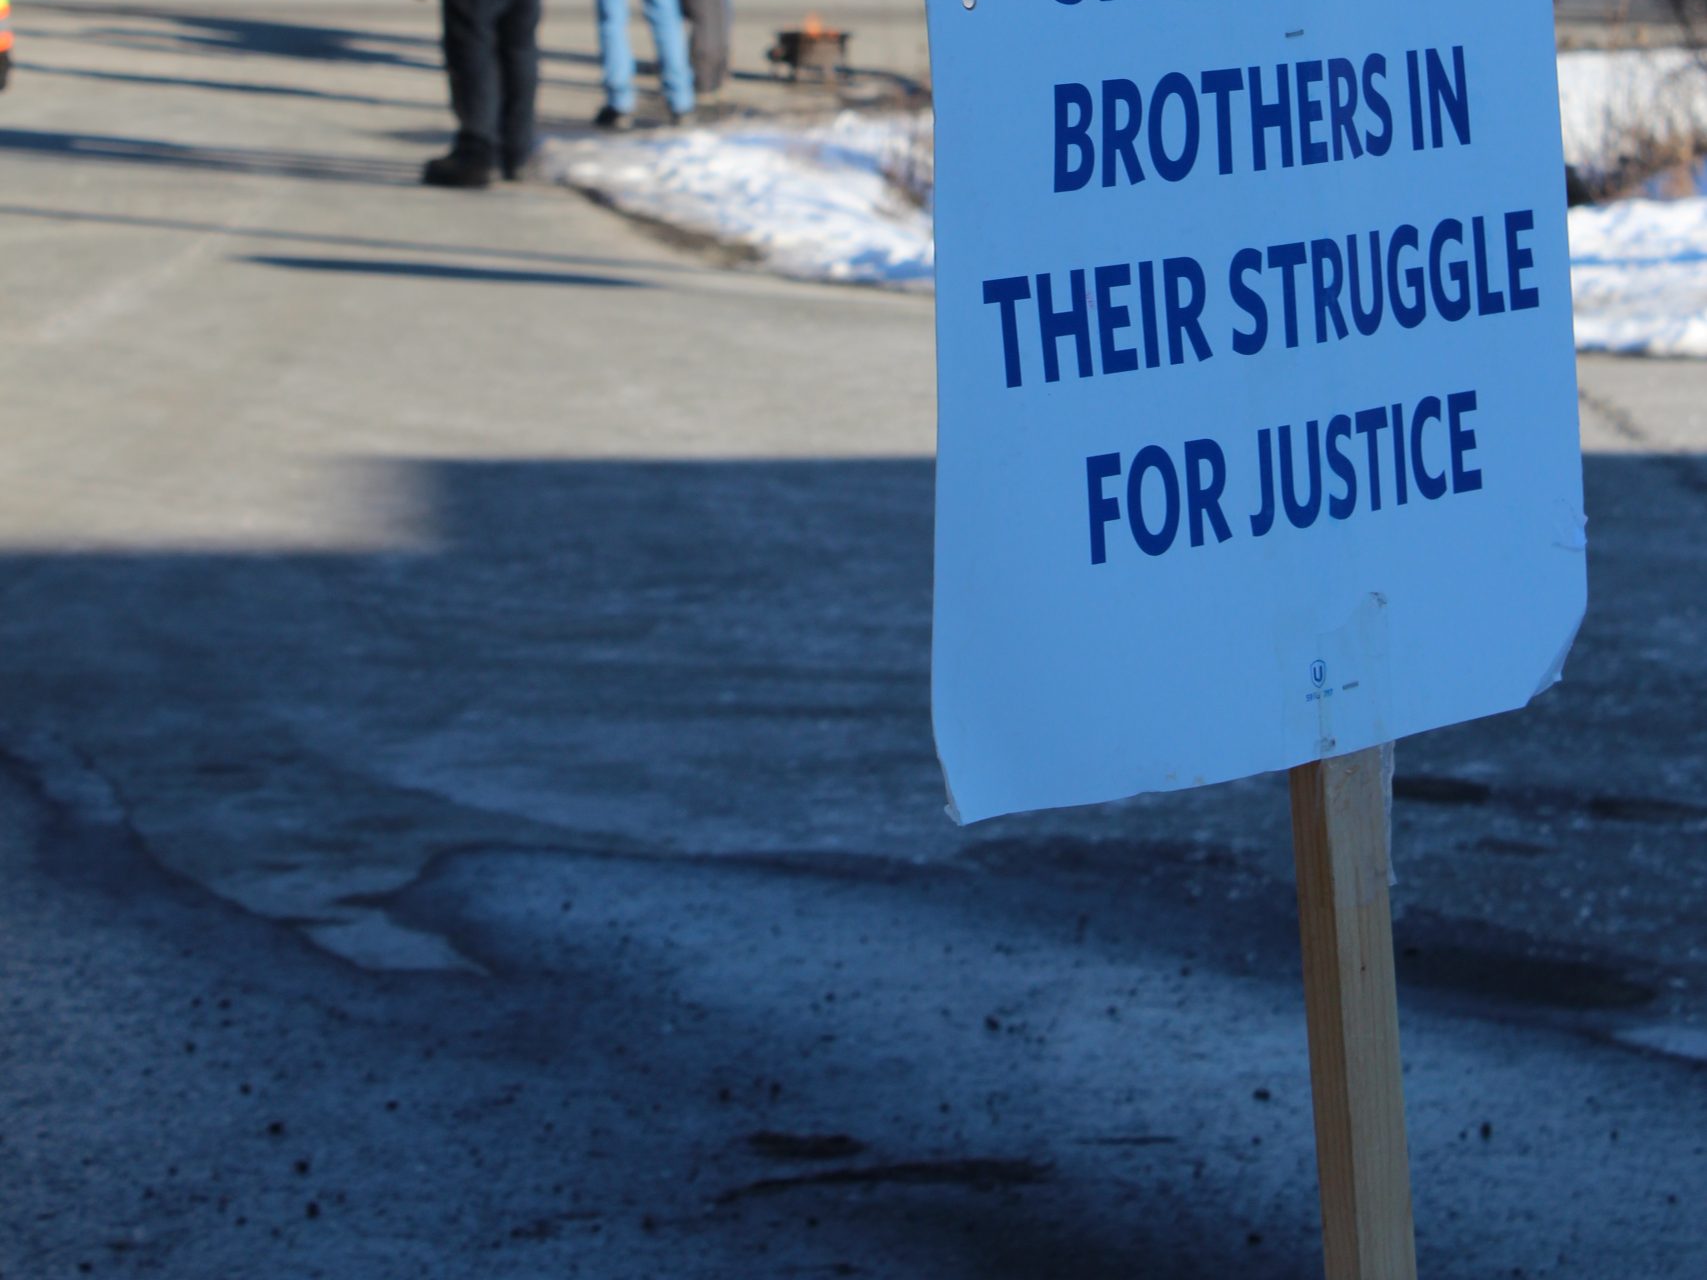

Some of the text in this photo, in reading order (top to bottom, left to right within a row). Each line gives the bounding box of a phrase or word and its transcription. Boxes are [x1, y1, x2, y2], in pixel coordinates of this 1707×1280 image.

[1053, 45, 1471, 193] BROTHERS IN
[982, 209, 1540, 388] THEIR STRUGGLE
[1086, 390, 1483, 565] FOR JUSTICE
